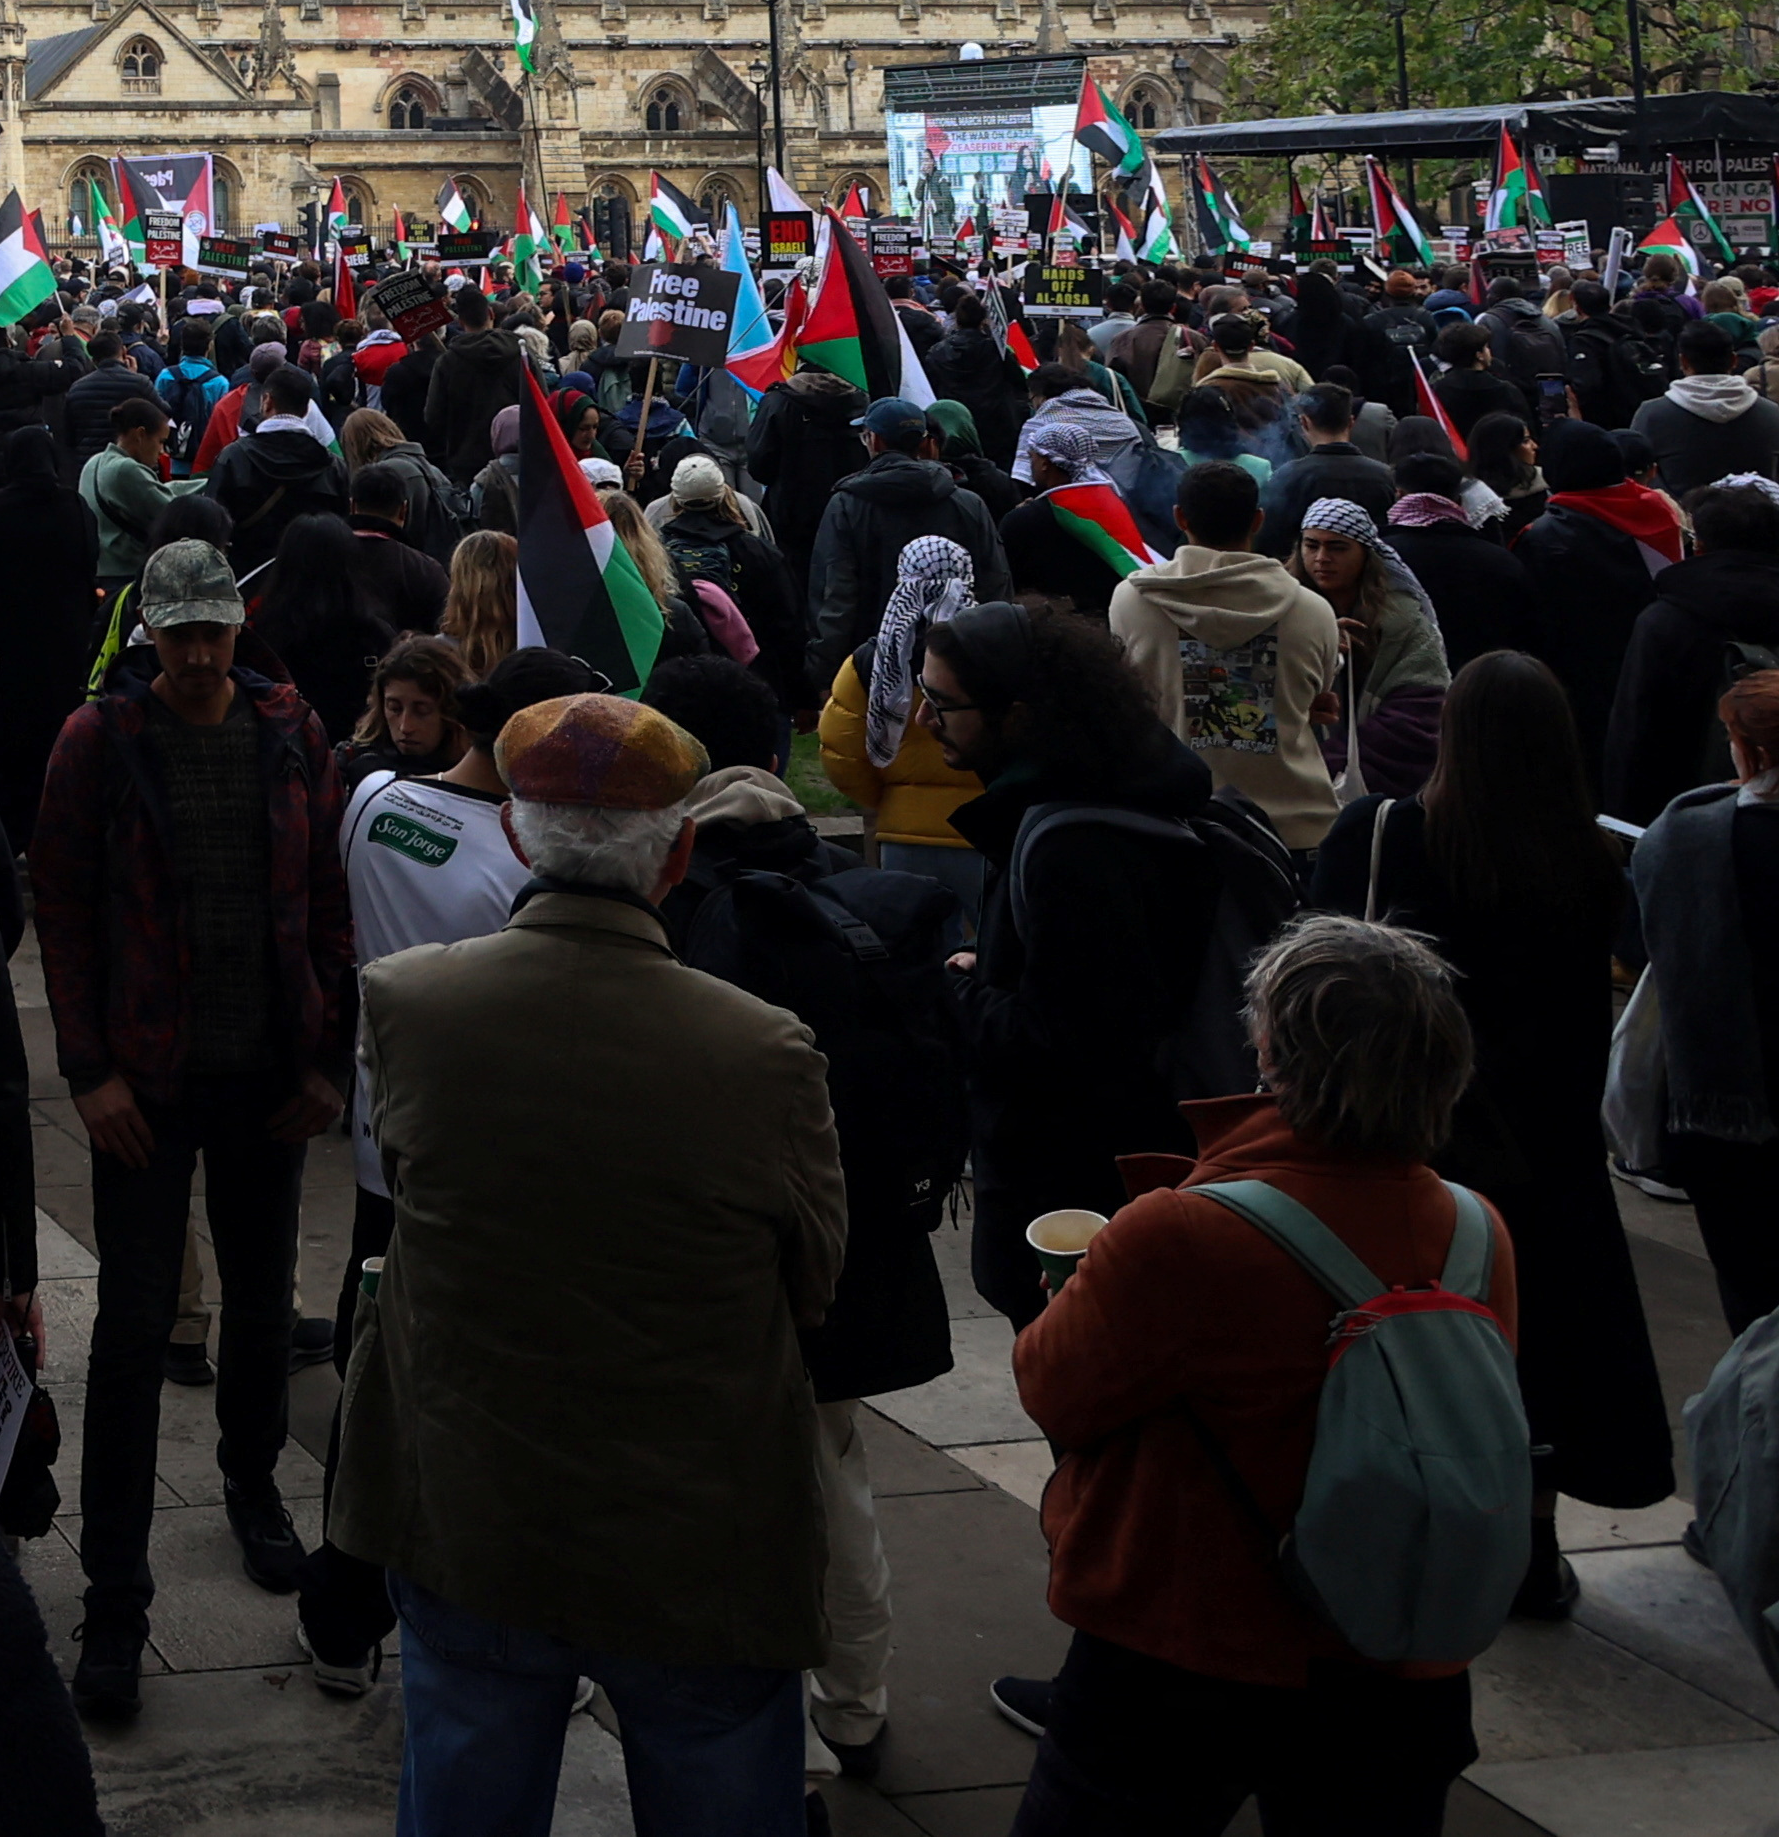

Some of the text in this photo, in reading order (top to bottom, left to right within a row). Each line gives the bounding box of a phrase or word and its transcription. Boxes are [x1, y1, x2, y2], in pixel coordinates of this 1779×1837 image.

[951, 142, 1003, 152] CEASEFIRE
[1725, 157, 1771, 173] PALES
[1740, 198, 1771, 213] NO
[149, 216, 180, 227] FREEDOM
[147, 229, 181, 241] PALESTINE
[769, 220, 808, 243] END
[874, 233, 908, 243] FREEDOM
[769, 241, 806, 254] ISRAELI
[873, 245, 910, 255] PALESTINE
[1563, 242, 1589, 256] REE
[200, 249, 248, 267] PALESTINE
[344, 253, 370, 267] SIEGE
[1041, 268, 1086, 281] HANDS
[648, 268, 700, 298] Free
[1050, 280, 1075, 292] OFF
[378, 278, 423, 304] FREEDOM
[386, 290, 435, 319] PALESTINE
[1035, 293, 1091, 306] AL-AQSA
[626, 297, 728, 331] Palestine
[375, 817, 447, 861] San Jorge
[914, 1178, 931, 1193] Y-3
